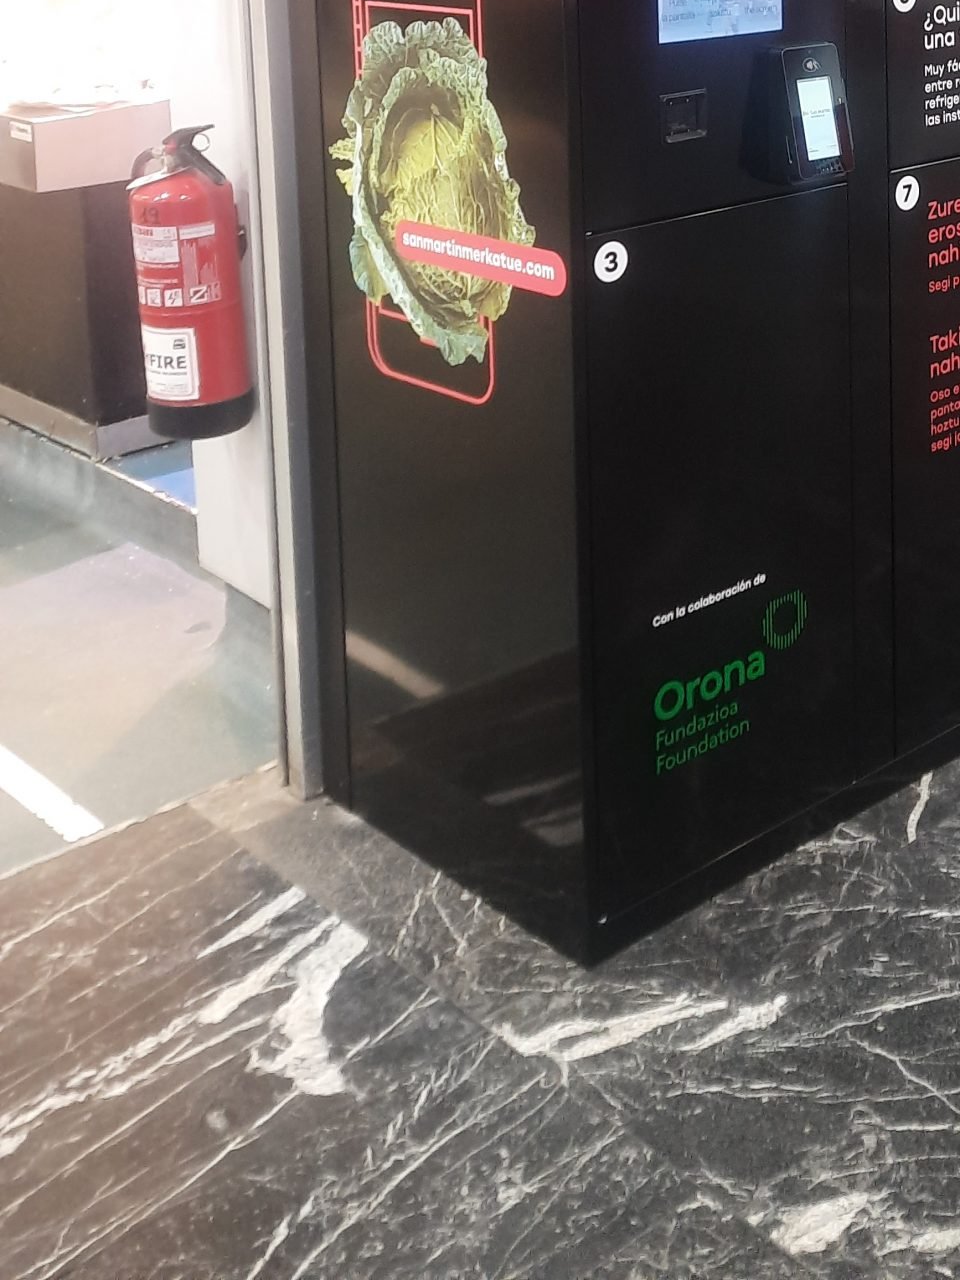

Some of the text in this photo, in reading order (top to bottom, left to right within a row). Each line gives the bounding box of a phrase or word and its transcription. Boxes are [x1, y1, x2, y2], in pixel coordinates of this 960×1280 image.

[924, 31, 955, 50] una
[924, 63, 944, 78] Muy
[924, 80, 953, 94] entre
[925, 113, 941, 127] las
[902, 184, 913, 203] 7
[402, 231, 555, 281] sanmartinmerkatue.com
[604, 252, 619, 273] 3
[928, 275, 951, 293] Segi
[145, 352, 187, 370] FIRE
[930, 388, 951, 403] Oso
[931, 415, 959, 435] hoztu
[931, 435, 952, 452] segi
[652, 573, 766, 628] Con la colaboración de
[654, 650, 765, 721] Orona
[655, 701, 738, 752] Fundazioa
[656, 718, 750, 776] Foundation
